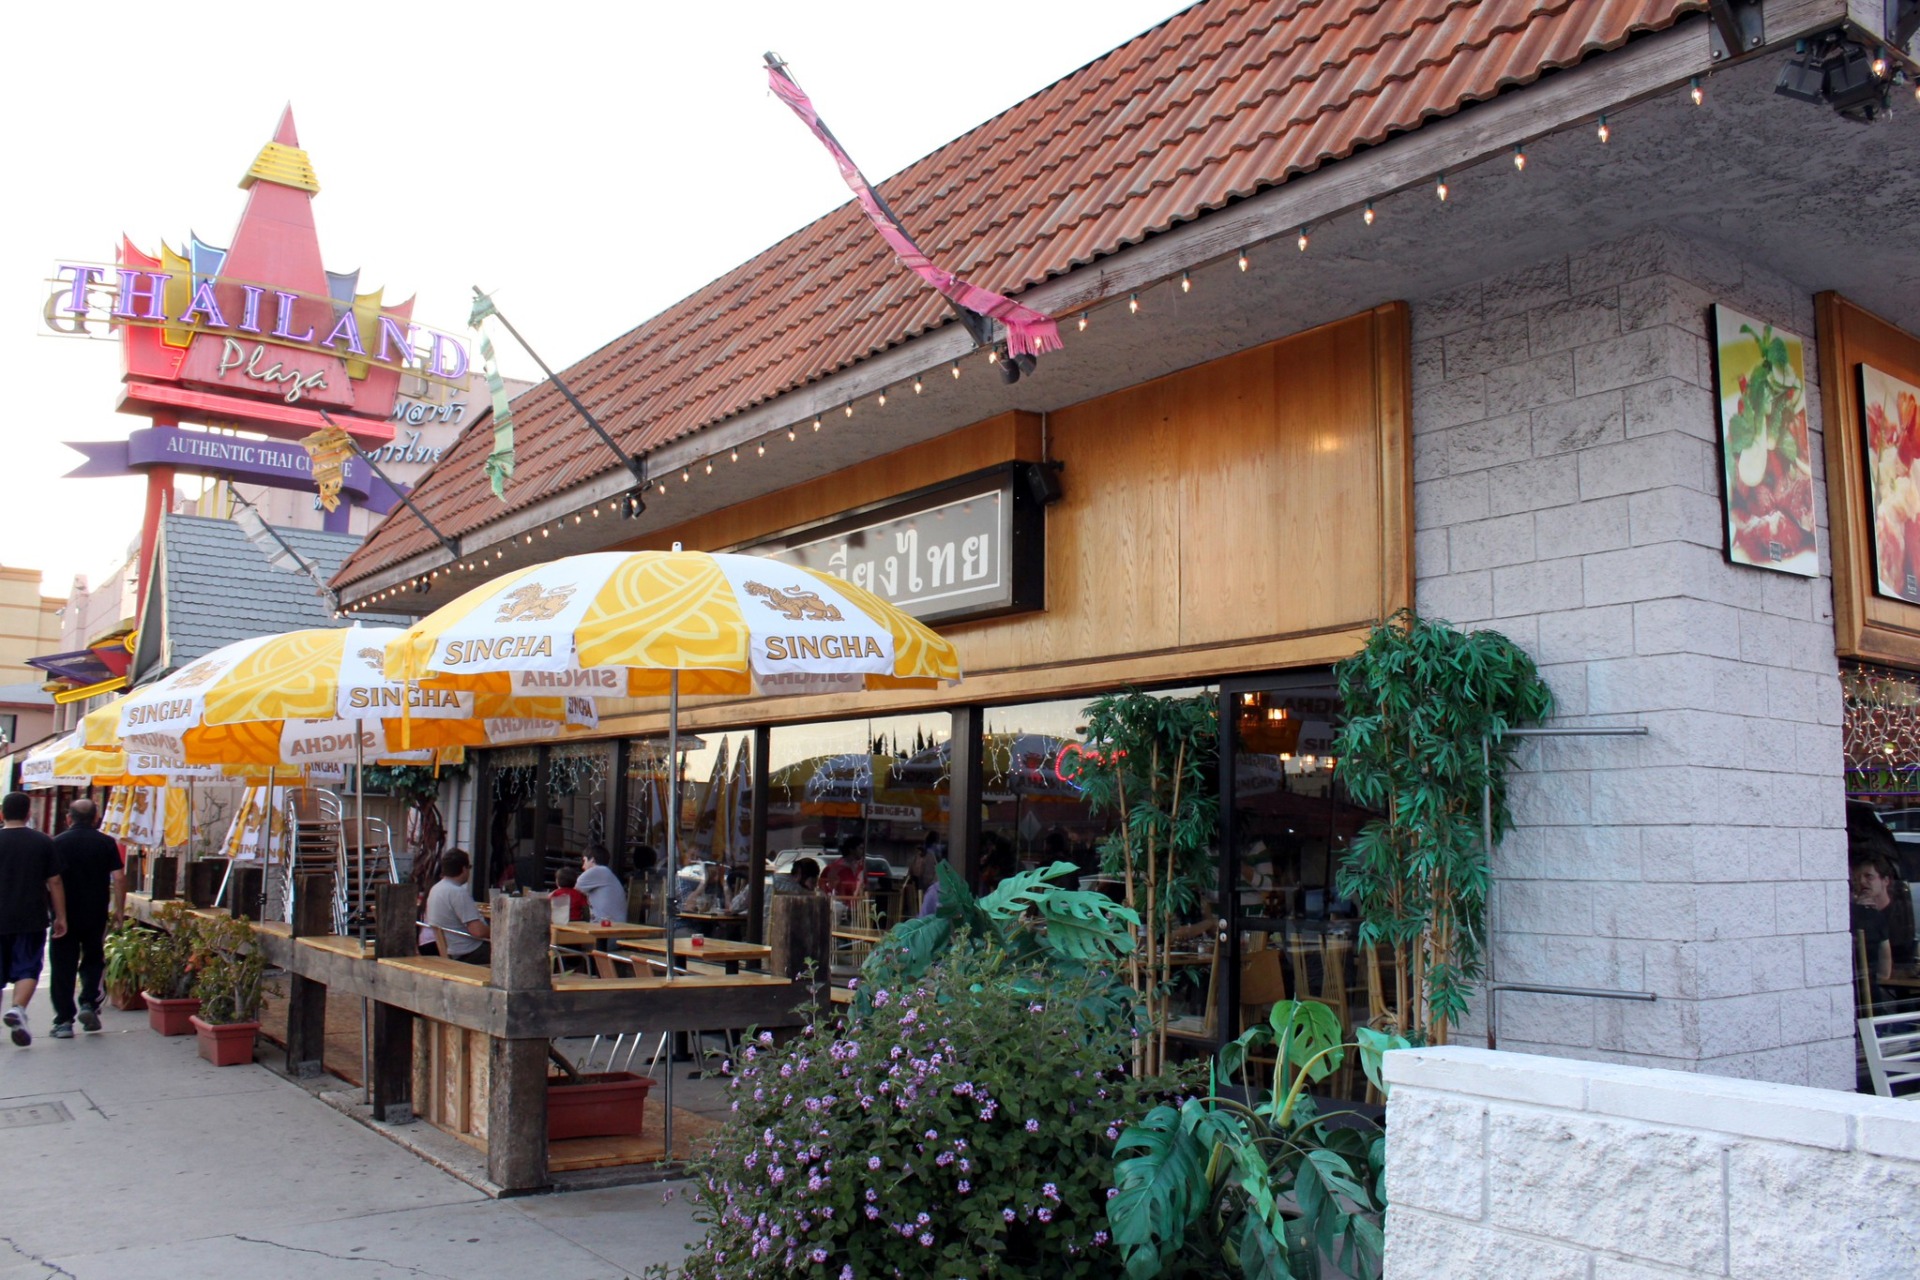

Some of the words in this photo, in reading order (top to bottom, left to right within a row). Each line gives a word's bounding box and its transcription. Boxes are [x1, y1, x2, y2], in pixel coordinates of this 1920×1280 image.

[57, 264, 469, 379] THAILAND
[217, 337, 328, 402] Plaza
[166, 436, 254, 463] AUTHENTIC
[257, 449, 293, 469] THAI
[443, 636, 552, 665] SINGHA
[765, 635, 884, 660] SINGHA
[349, 686, 462, 708] SINGHA
[127, 698, 193, 727] SINGHA
[305, 761, 341, 774] INGHA
